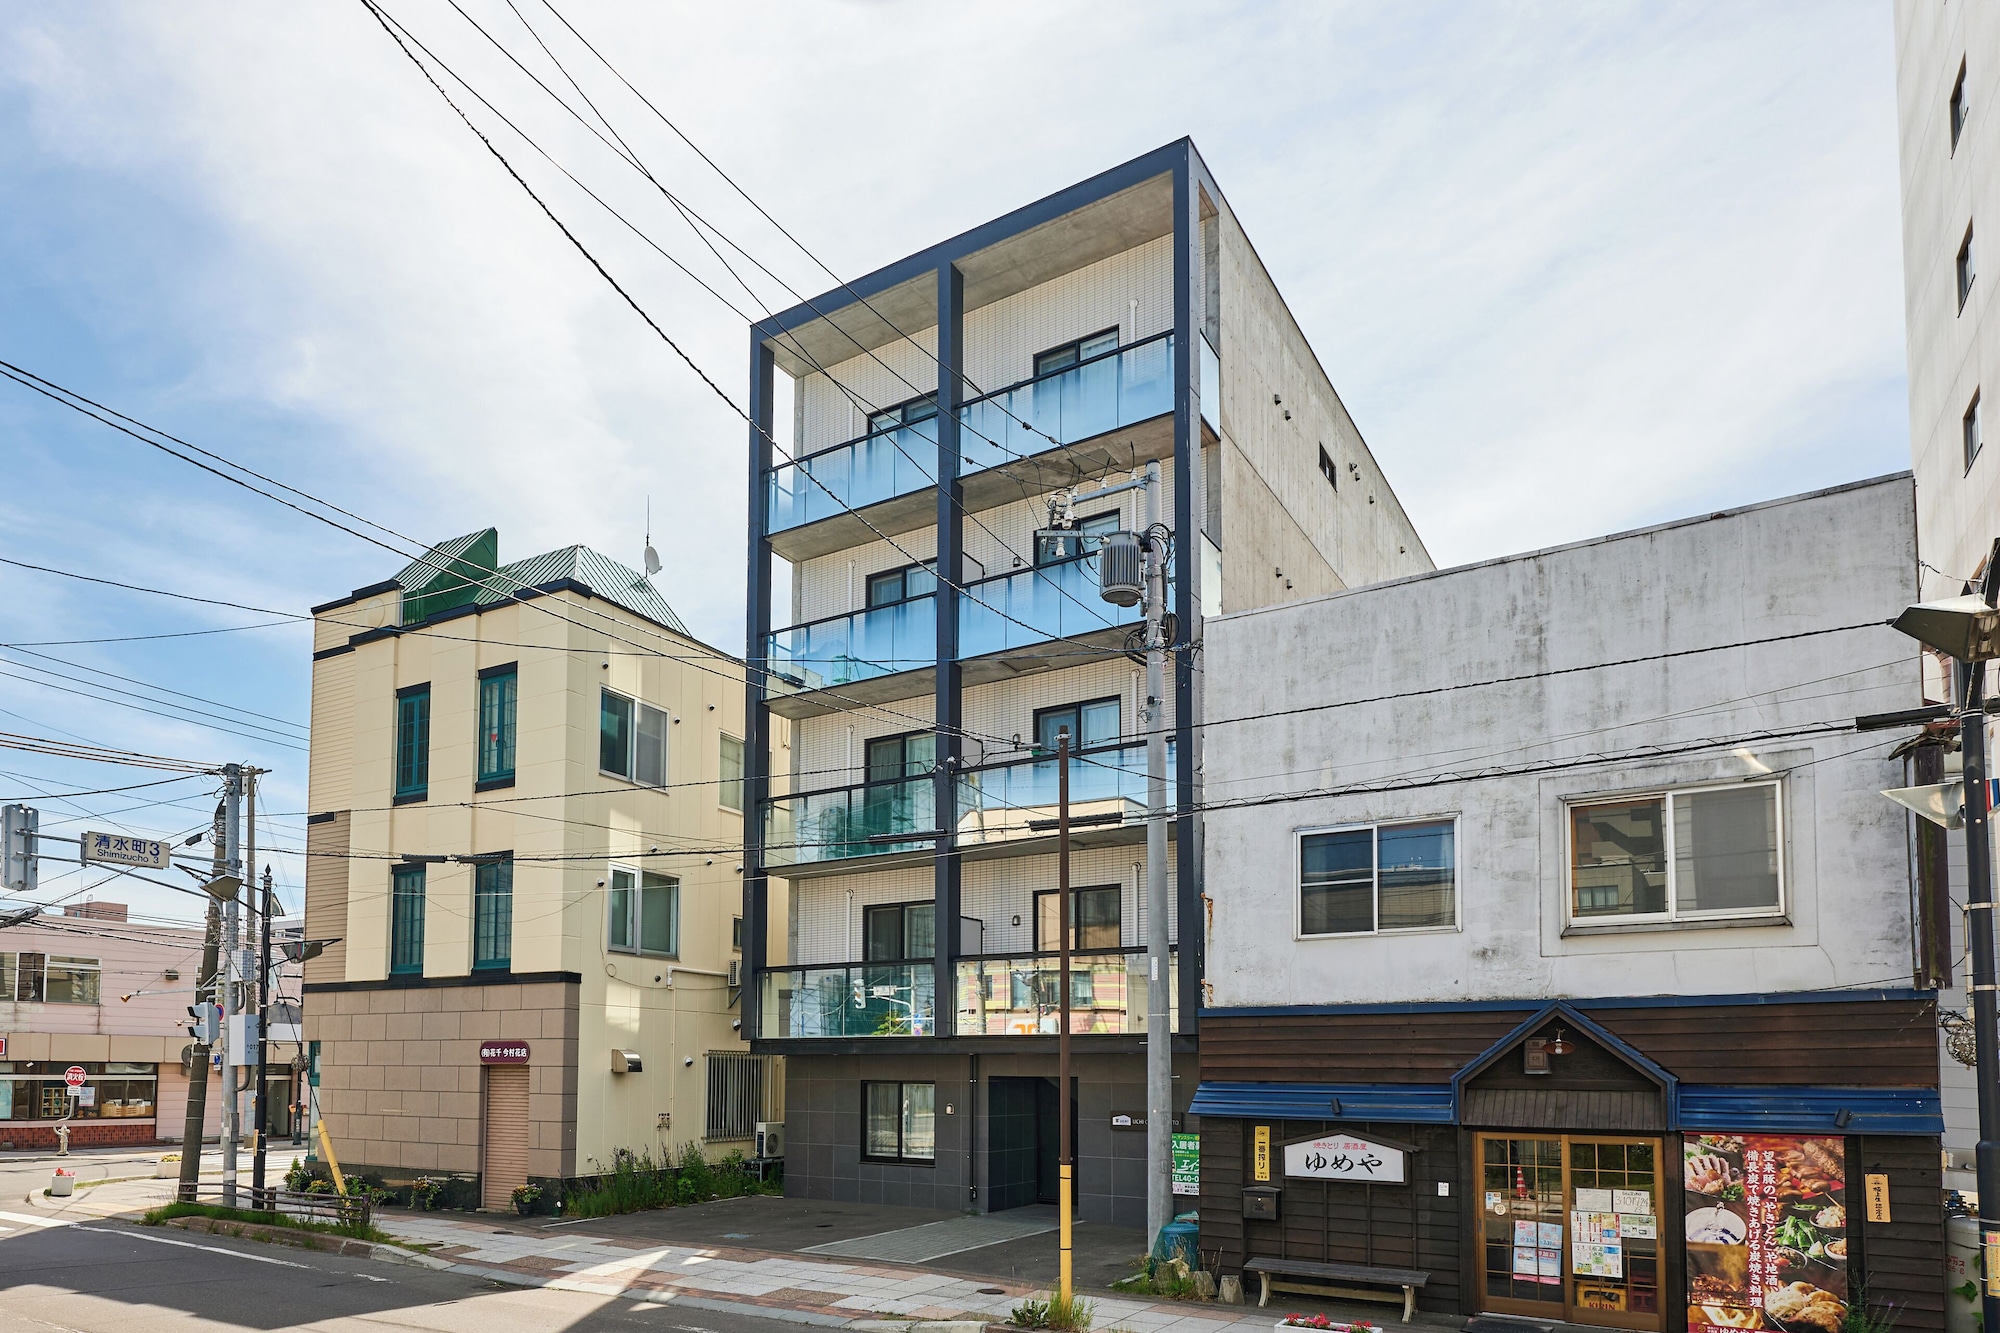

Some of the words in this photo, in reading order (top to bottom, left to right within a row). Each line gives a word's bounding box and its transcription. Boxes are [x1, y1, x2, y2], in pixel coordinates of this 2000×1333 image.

[94, 833, 160, 857] 清水町3
[97, 848, 149, 863] Shimizucho
[153, 856, 160, 864] 3
[503, 1048, 527, 1057] 今村花店
[1313, 1142, 1340, 1150] 焼きとり
[1343, 1142, 1367, 1151] 居酒屋
[1304, 1152, 1383, 1175] ゆめや
[1745, 1149, 1764, 1309] 備長炭で焼きあげる炭焼き料理
[1589, 1302, 1616, 1310] KIRIN
